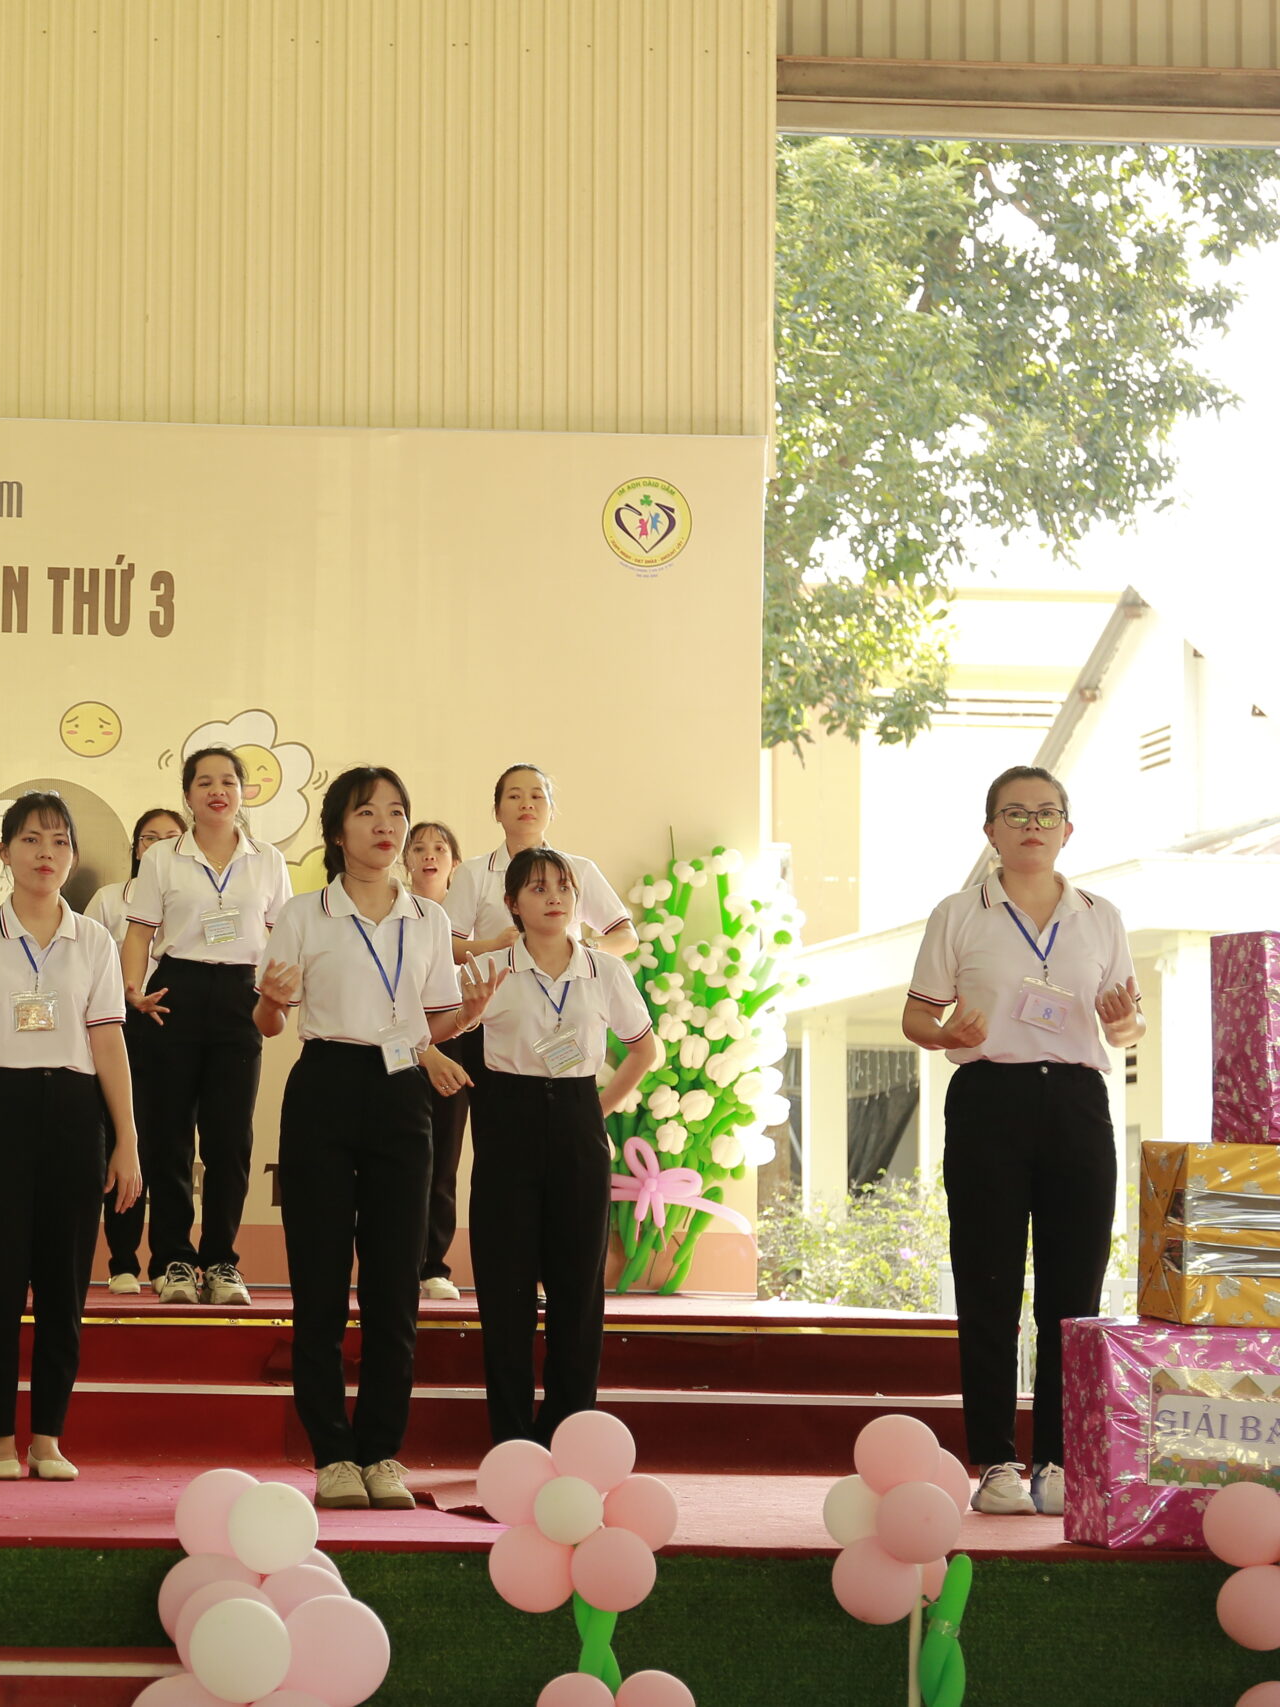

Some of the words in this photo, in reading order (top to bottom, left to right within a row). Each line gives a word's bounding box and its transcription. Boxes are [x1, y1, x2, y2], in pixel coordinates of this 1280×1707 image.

[47, 554, 137, 638] THỨ
[149, 570, 176, 639] 3
[1042, 1007, 1053, 1020] 8
[1155, 1403, 1228, 1440] GIẢI
